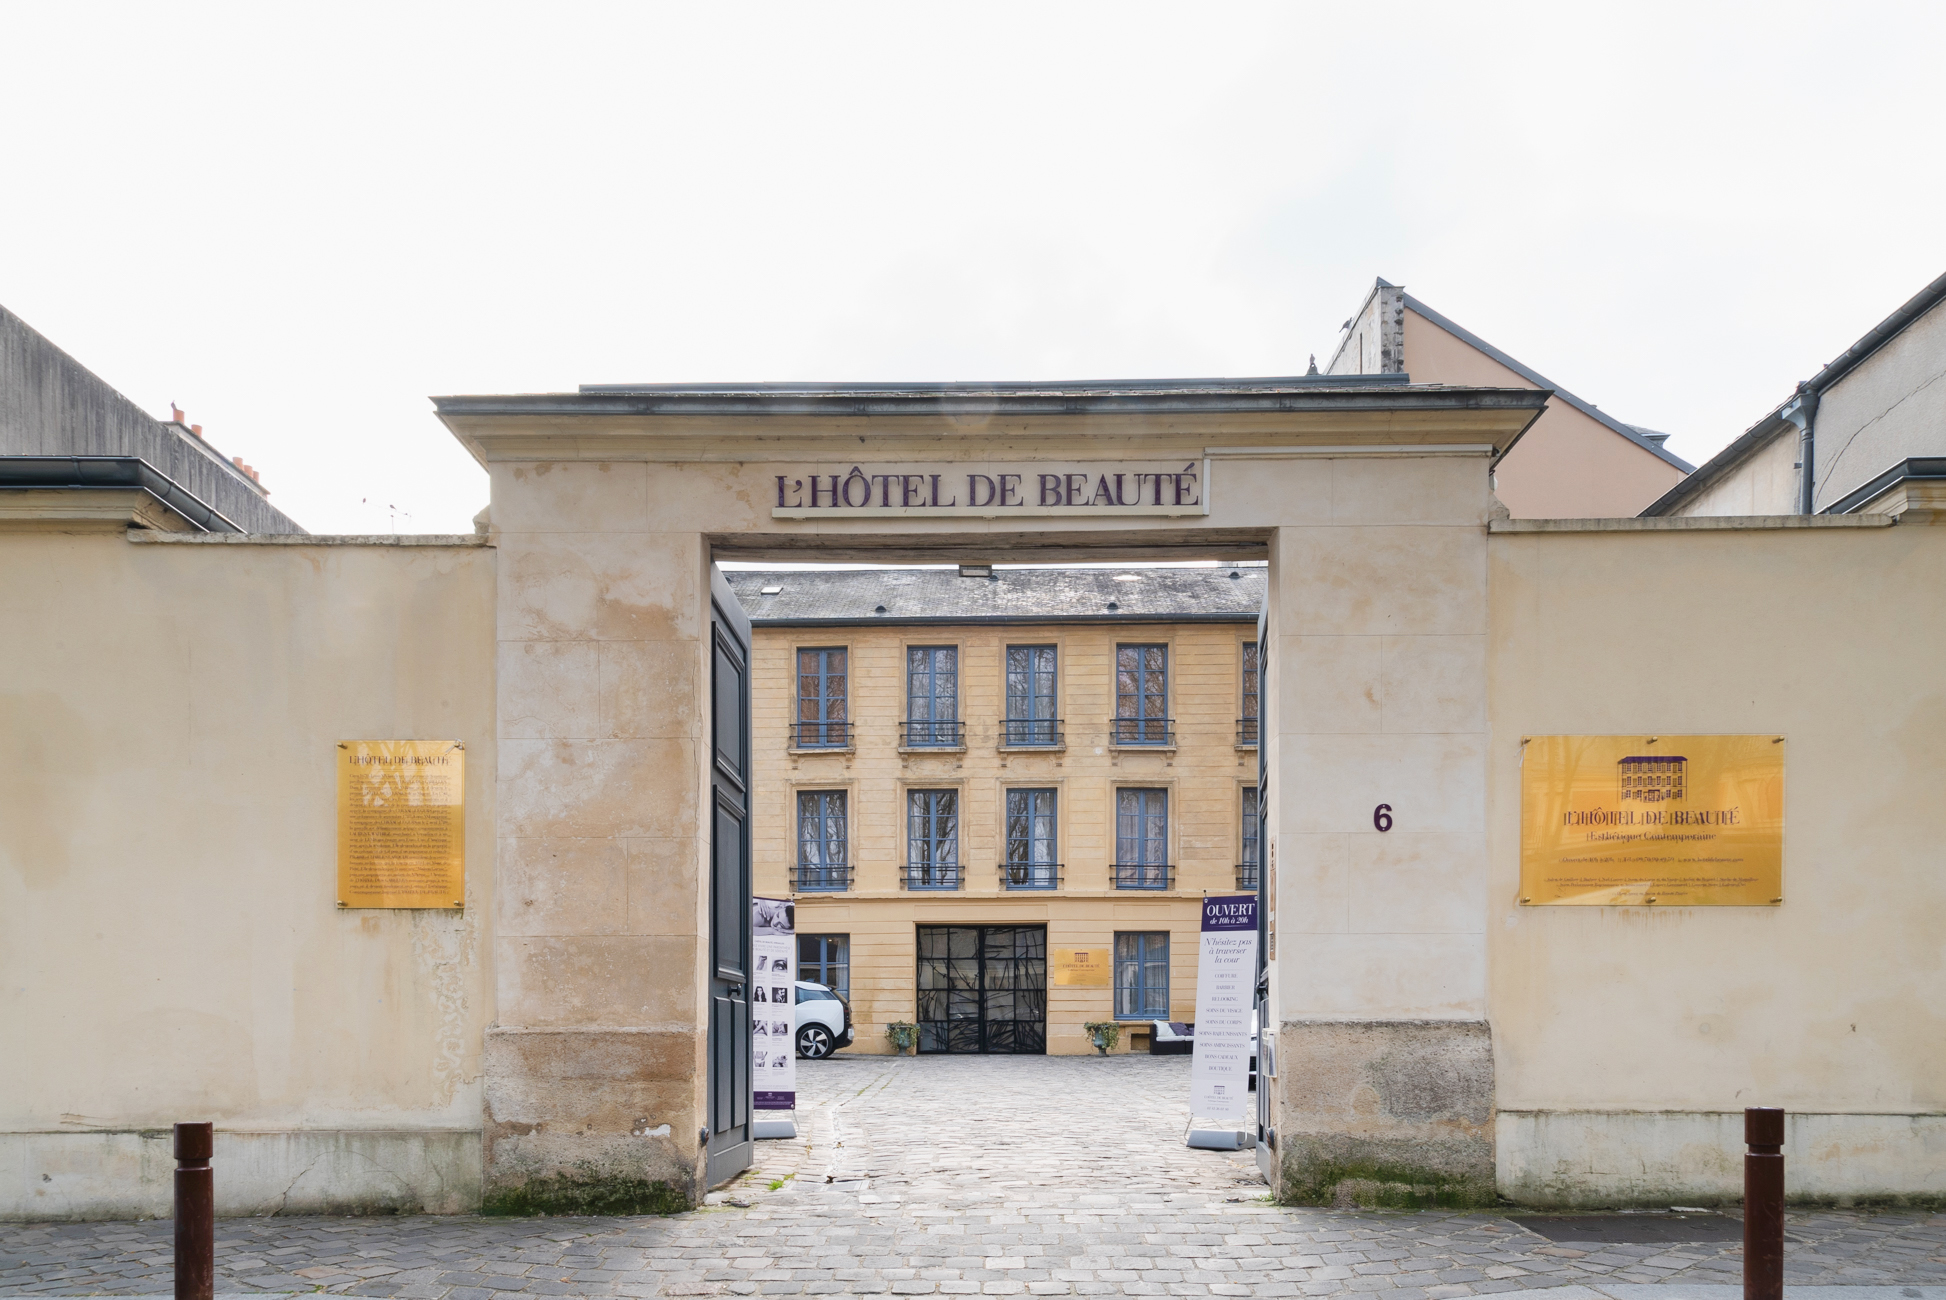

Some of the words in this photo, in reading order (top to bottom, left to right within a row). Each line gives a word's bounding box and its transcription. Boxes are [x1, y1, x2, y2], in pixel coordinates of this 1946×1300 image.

[774, 466, 956, 508] L'HÔTEL
[967, 474, 1024, 507] DE
[1036, 462, 1199, 507] BEAUTÉ
[1374, 803, 1393, 832] 6
[1645, 810, 1668, 824] DE
[1674, 806, 1740, 824] BEAUTÉ
[1590, 831, 1641, 843] Esthétique
[1643, 831, 1717, 843] Contemporaine
[1206, 903, 1255, 917] OUVERT
[1209, 917, 1218, 925] de
[1236, 916, 1249, 924] 20h
[1238, 939, 1253, 948] pas
[1208, 946, 1214, 955] à
[1214, 955, 1222, 964] la
